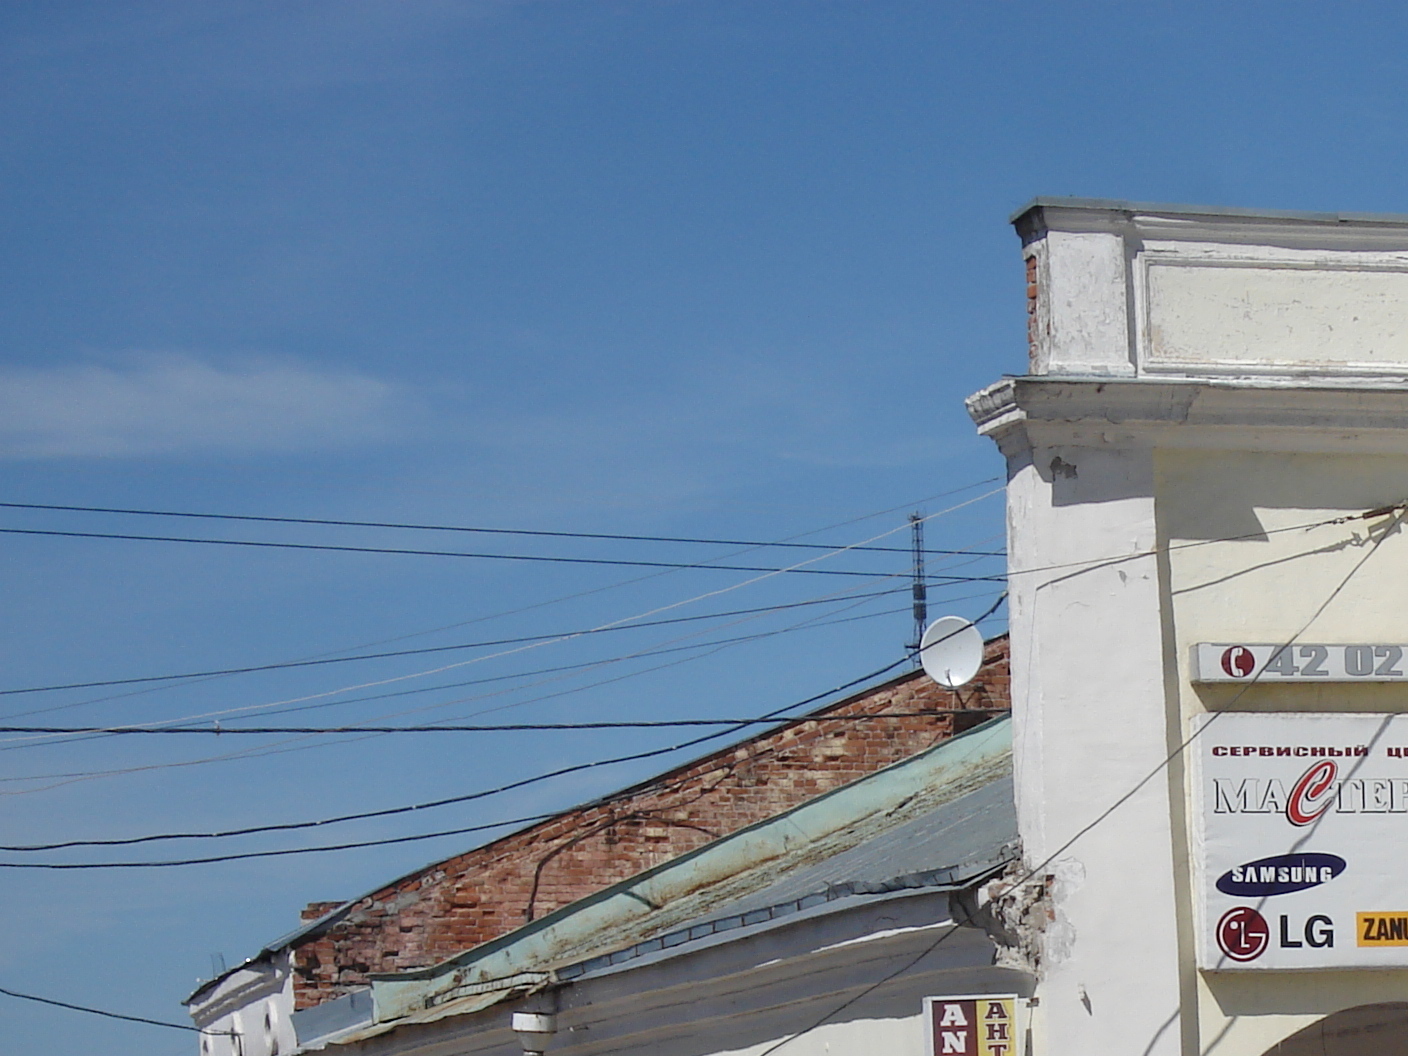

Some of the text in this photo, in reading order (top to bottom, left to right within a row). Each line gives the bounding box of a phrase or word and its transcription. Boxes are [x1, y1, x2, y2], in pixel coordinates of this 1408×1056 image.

[1267, 645, 1328, 676] 42
[1345, 645, 1402, 676] 02
[1212, 745, 1369, 758] СЕРВИСНЫЙ
[1231, 865, 1333, 884] SAMSUNG
[1279, 914, 1334, 948] LG
